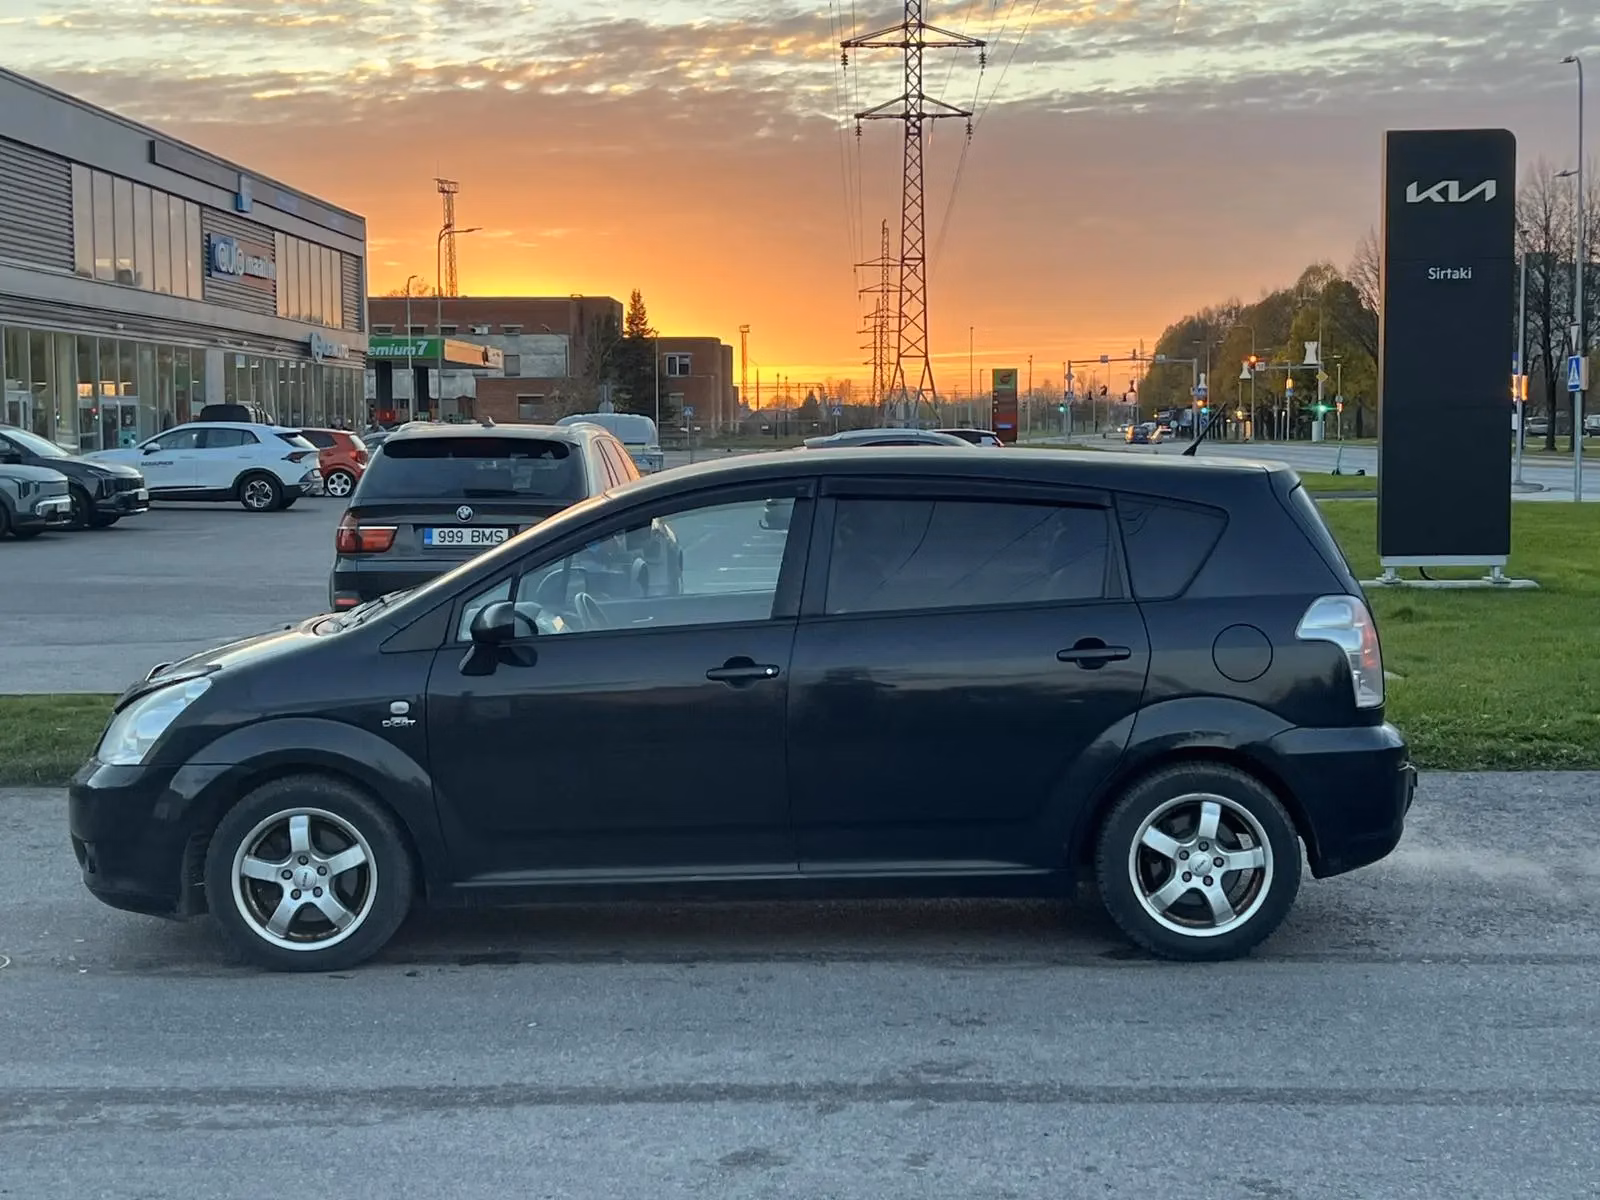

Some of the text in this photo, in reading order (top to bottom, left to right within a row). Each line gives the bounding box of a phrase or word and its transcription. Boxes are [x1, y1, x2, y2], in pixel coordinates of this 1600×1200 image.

[1406, 180, 1496, 202] KIA
[1428, 267, 1472, 280] Sirtaki
[438, 530, 504, 543] 999 BMS
